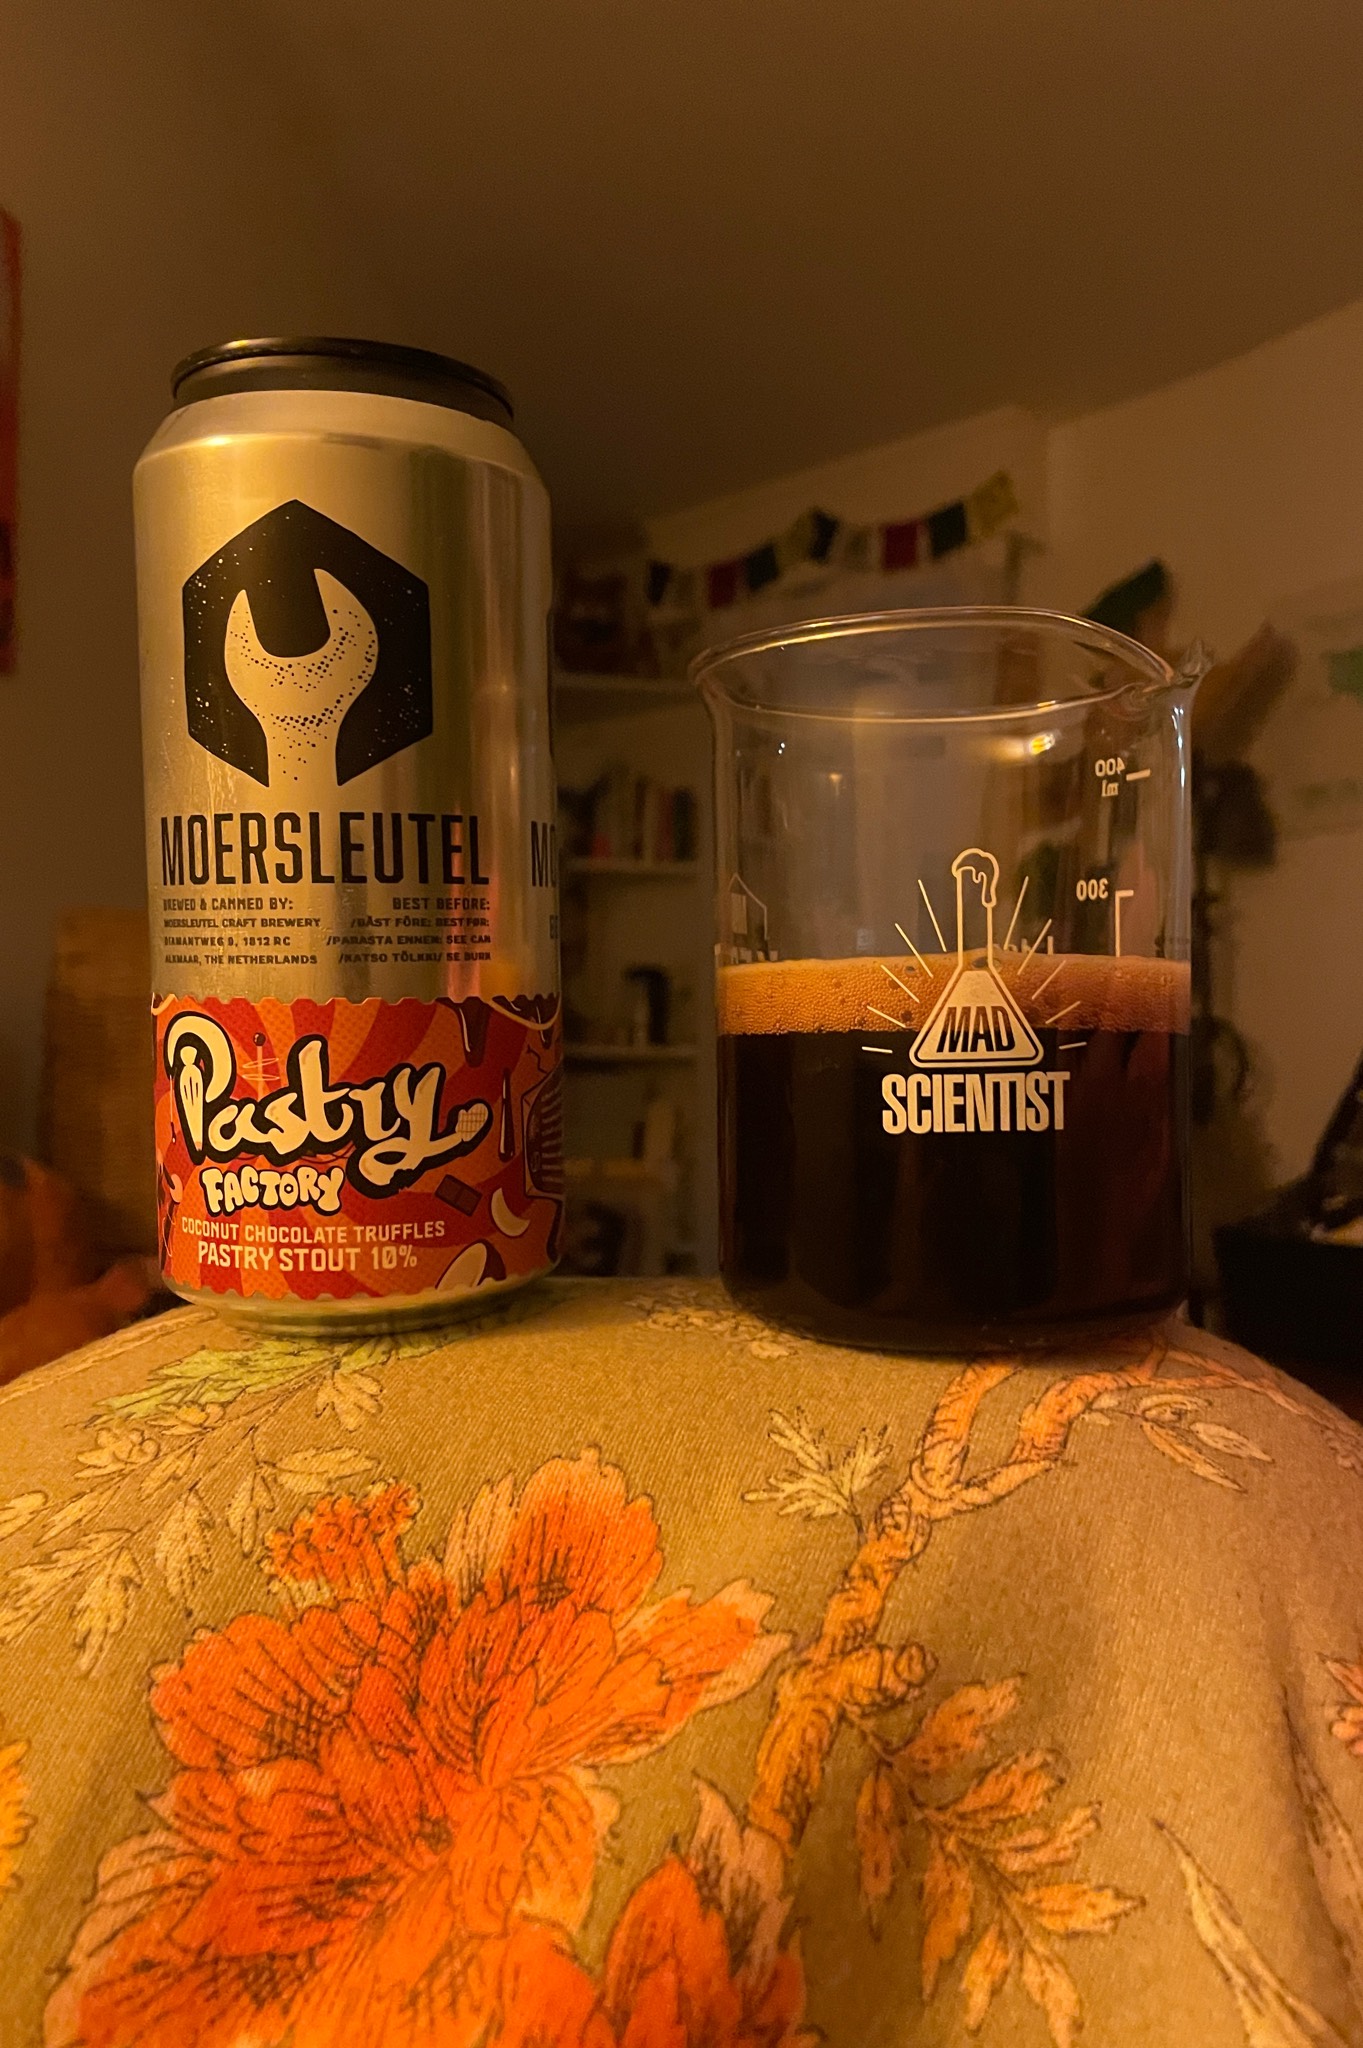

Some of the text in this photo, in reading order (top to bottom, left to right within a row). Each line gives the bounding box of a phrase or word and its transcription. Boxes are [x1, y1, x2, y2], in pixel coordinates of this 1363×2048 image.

[161, 812, 490, 886] MOERSLEUTEL
[163, 896, 294, 911] BREWED & CANNED BY:
[392, 898, 491, 911] BEST BEFORE:
[164, 918, 321, 928] MOERSLEUTEL CRAFT BREWERY
[243, 936, 271, 946] 1812
[446, 935, 469, 945] SEE
[470, 934, 491, 944] CAN
[204, 954, 224, 965] THE
[227, 954, 318, 965] NETHERLANDS
[446, 952, 462, 962] SE
[936, 1005, 1016, 1053] MAD
[165, 1012, 492, 1194] Pastry
[881, 1071, 1071, 1135] SCIENTIST
[201, 1167, 344, 1216] FACTORY
[181, 1216, 446, 1244] COCONUT CHOCOLATE TRUFFLES
[197, 1241, 418, 1272] PASTRY STOUT 10%
